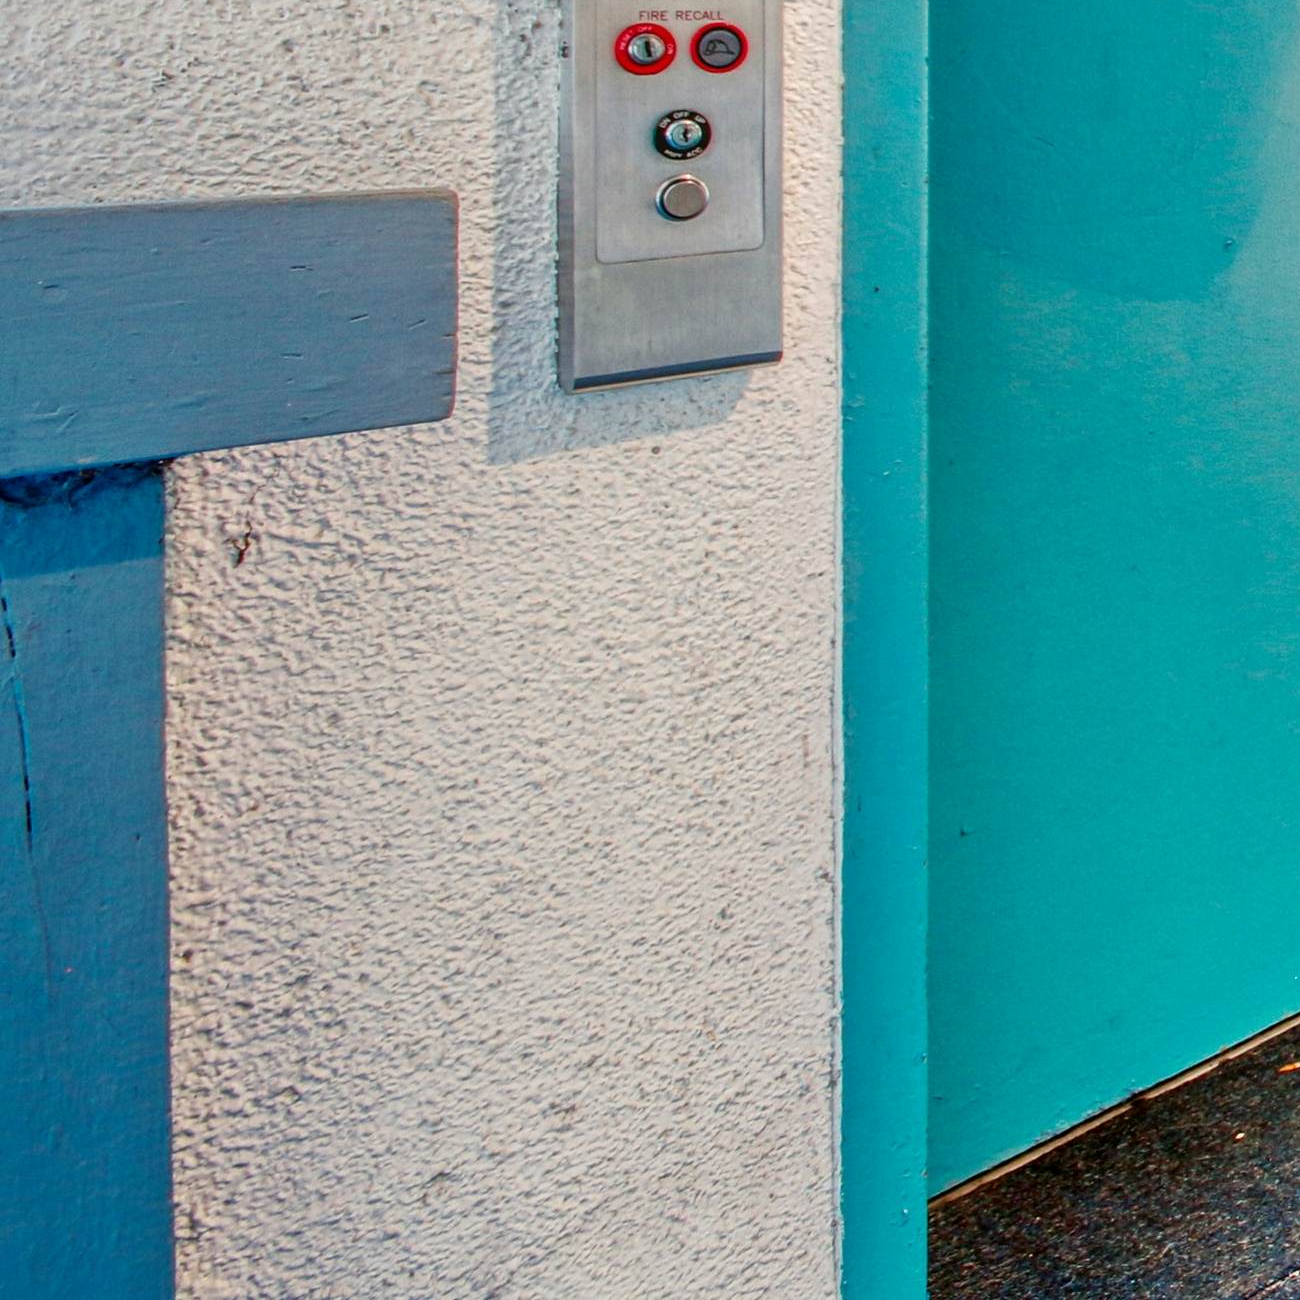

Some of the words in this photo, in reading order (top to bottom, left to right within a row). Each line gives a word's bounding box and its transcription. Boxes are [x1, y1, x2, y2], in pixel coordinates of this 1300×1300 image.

[638, 10, 668, 21] FIRE
[675, 10, 724, 21] RECALL
[672, 111, 689, 120] OFF
